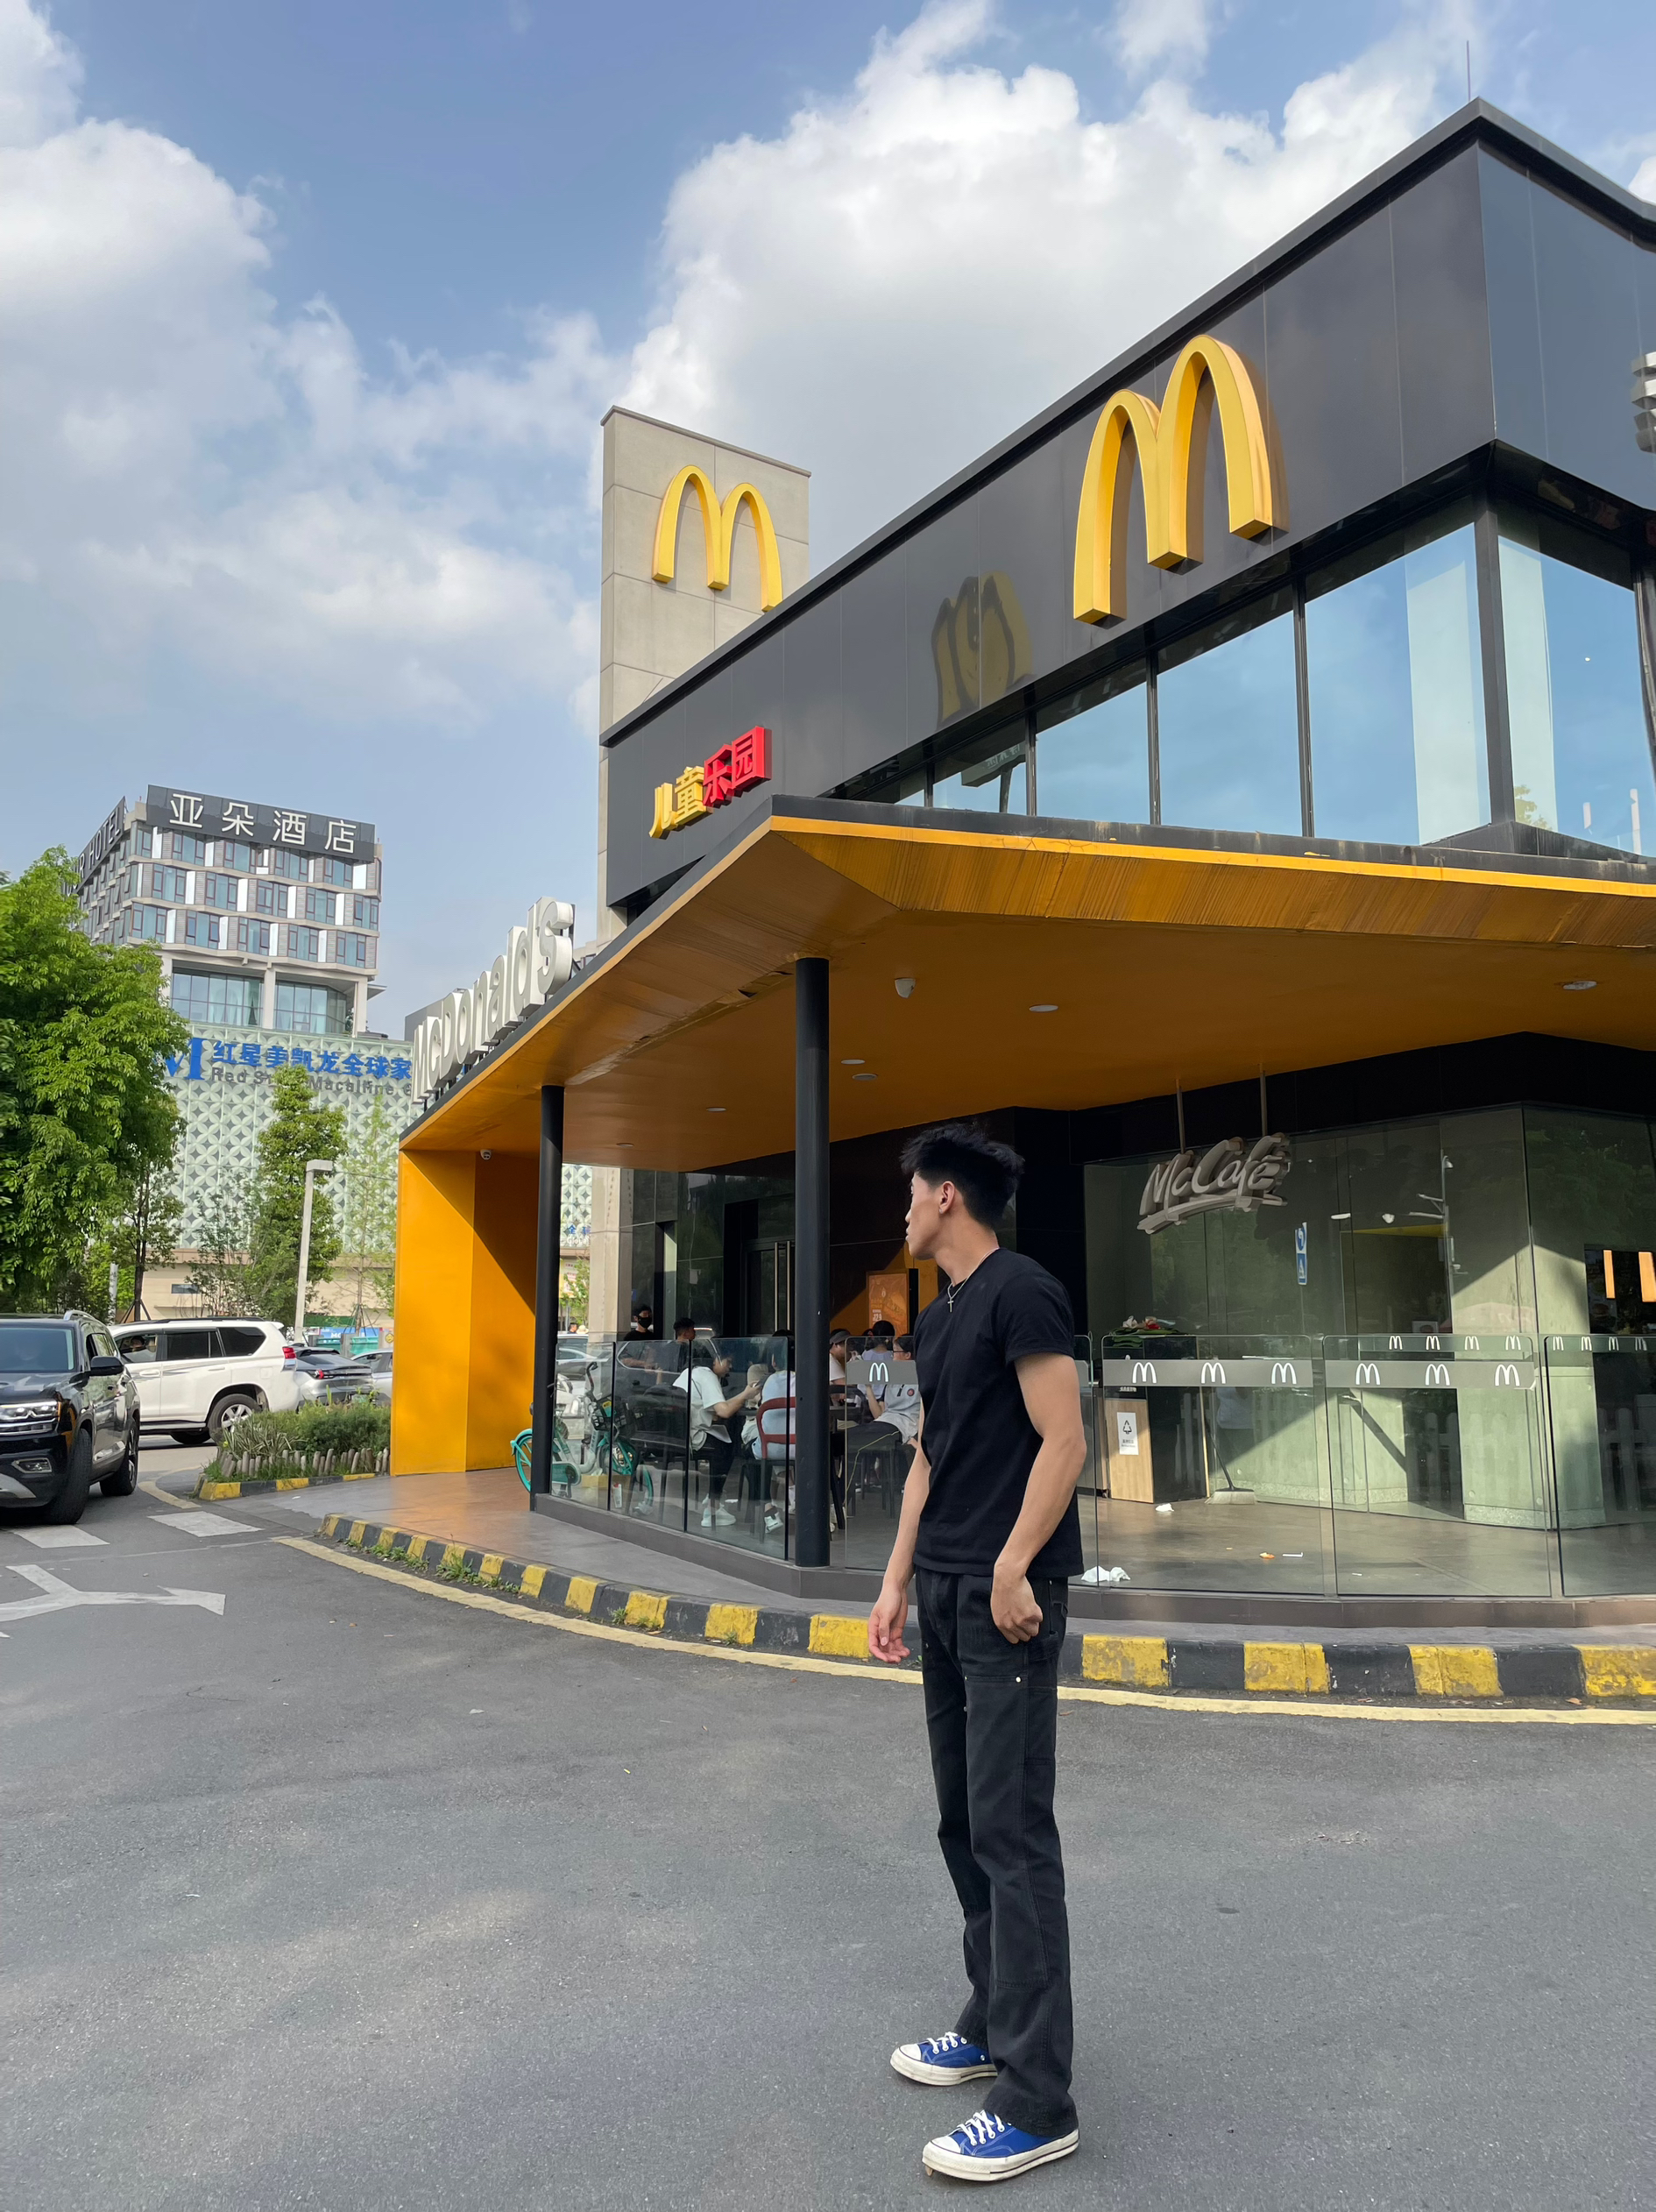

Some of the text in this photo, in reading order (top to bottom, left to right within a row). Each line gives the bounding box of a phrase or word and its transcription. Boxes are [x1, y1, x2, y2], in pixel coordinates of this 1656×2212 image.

[649, 726, 766, 839] 儿童乐园
[88, 806, 121, 870] HOTEL
[170, 793, 357, 854] 亚朵酒店
[211, 1067, 247, 1083] Red
